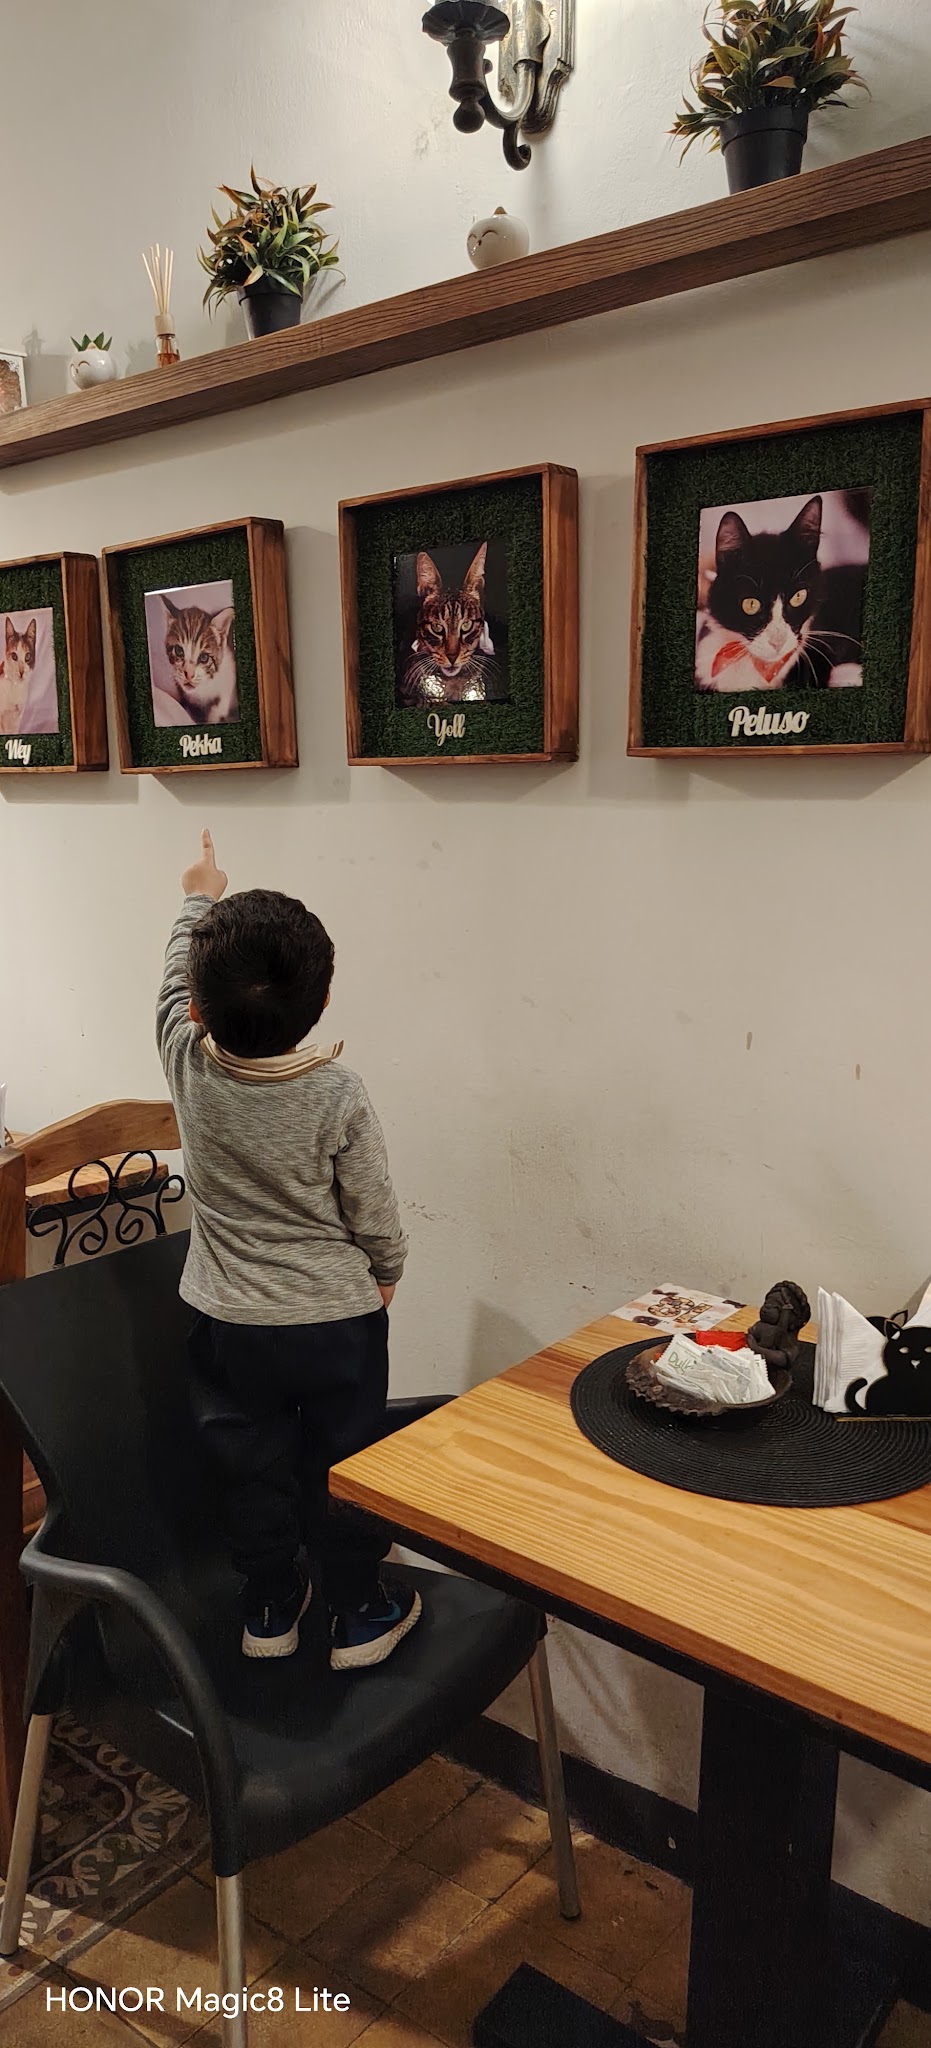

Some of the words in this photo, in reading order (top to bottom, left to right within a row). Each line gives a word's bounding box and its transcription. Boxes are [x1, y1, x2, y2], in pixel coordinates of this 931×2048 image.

[426, 713, 466, 747] Yoll
[728, 705, 810, 737] Peluso
[5, 738, 32, 765] Wey
[179, 733, 222, 758] Pekka
